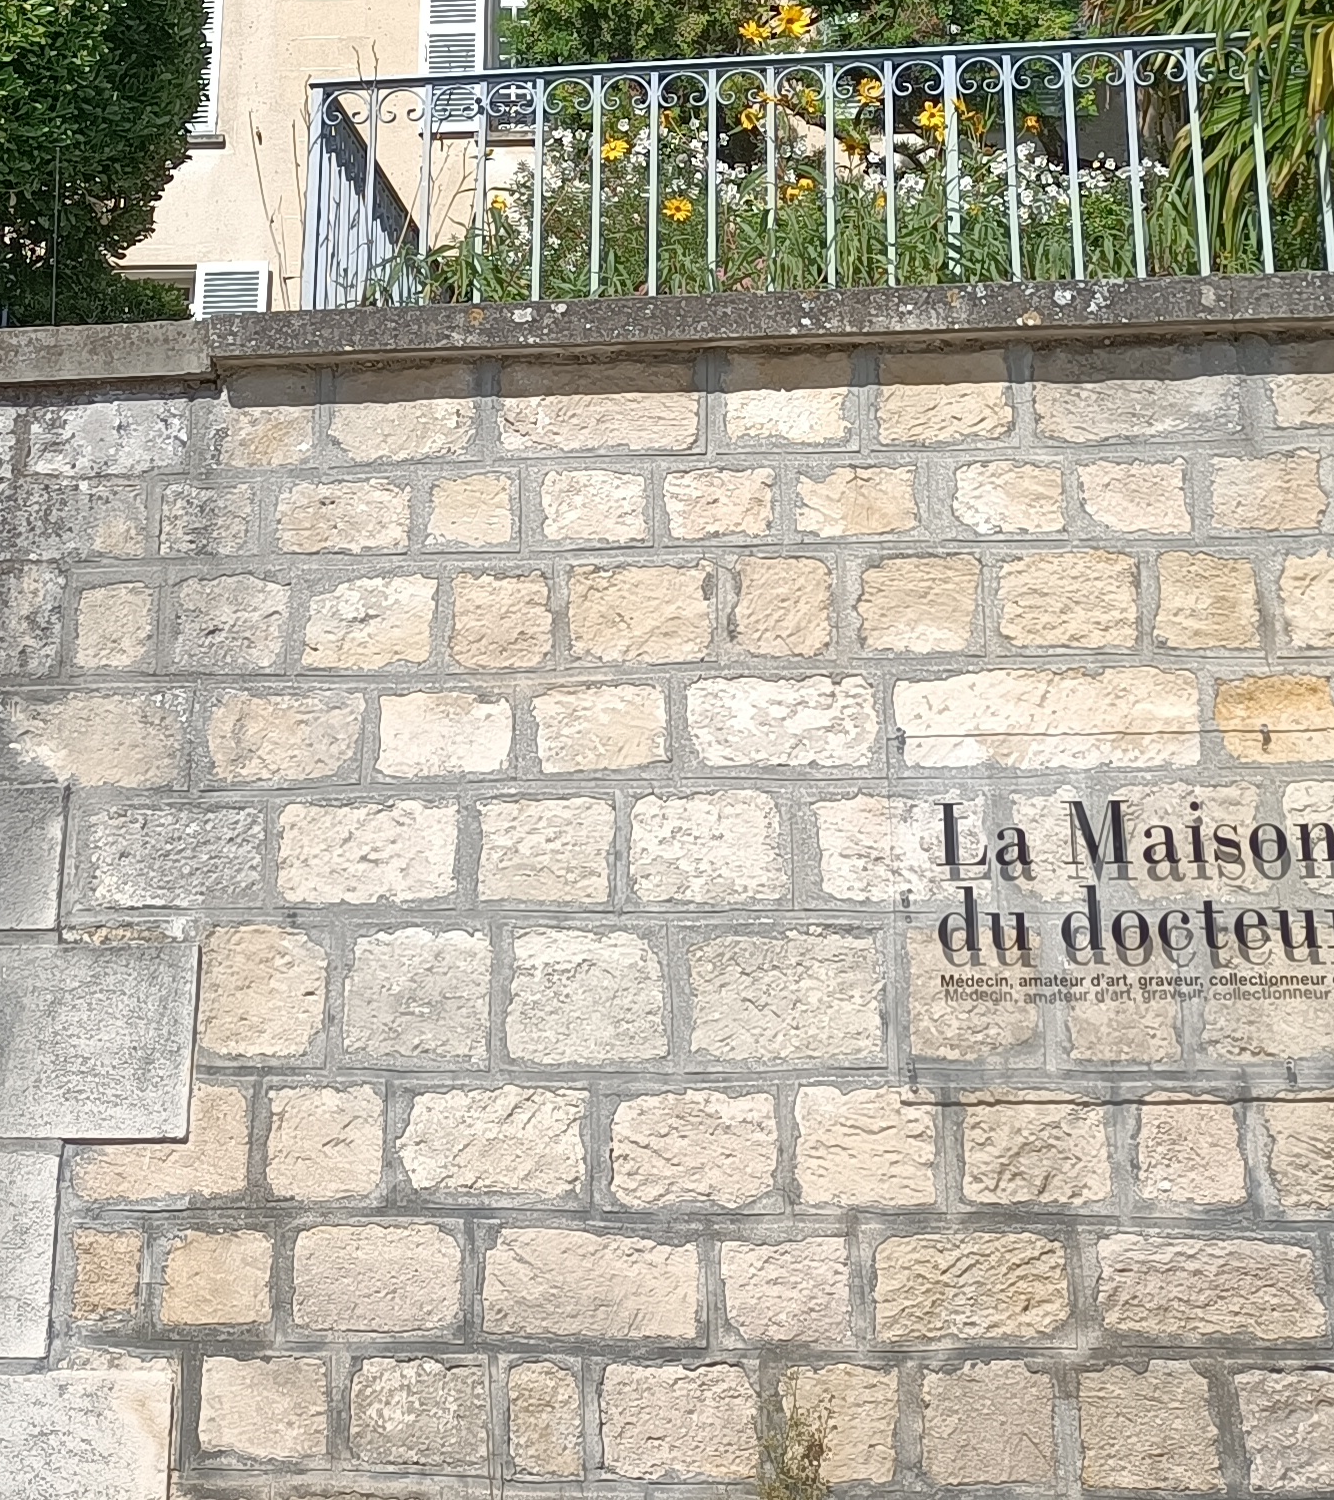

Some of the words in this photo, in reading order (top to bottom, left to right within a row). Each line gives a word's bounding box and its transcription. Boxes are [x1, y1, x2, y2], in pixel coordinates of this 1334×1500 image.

[934, 801, 1034, 866] La
[937, 885, 1033, 953] du
[940, 973, 1014, 990] Médecin,
[1018, 974, 1086, 988] amateur
[1090, 973, 1133, 990] d'art,
[1138, 974, 1204, 989] graveur,
[1209, 972, 1328, 987] collectionneur
